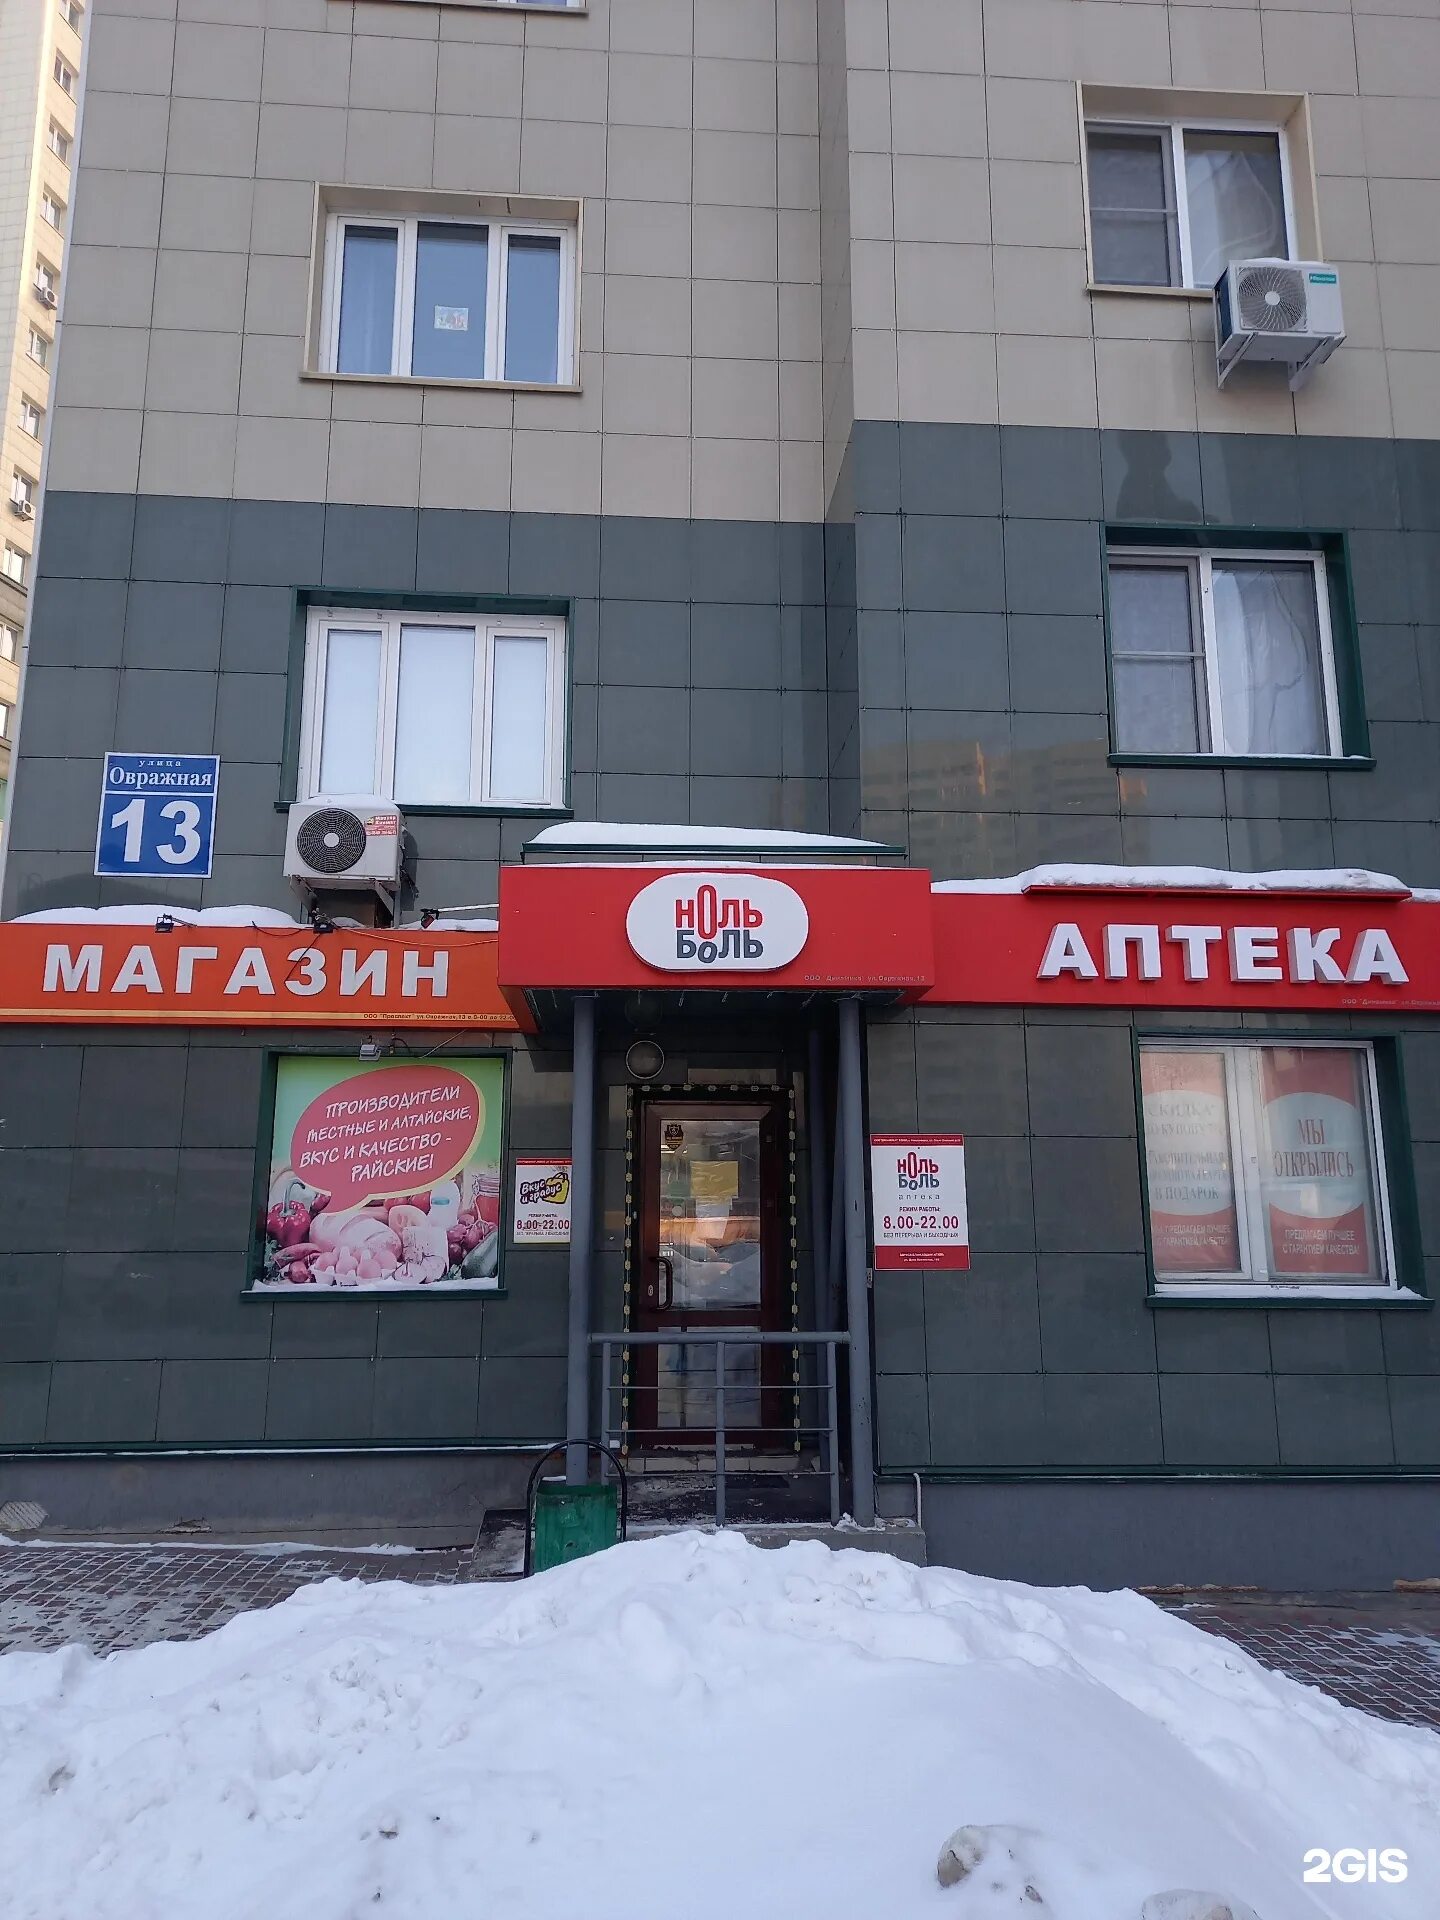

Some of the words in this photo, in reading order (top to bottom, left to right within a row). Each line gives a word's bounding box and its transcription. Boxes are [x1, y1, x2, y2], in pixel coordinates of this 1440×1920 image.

[109, 766, 213, 790] Овражная
[111, 798, 201, 865] 13
[1036, 923, 1410, 984] АПТЕКА
[42, 944, 449, 997] МАГАЗИН
[326, 1085, 460, 1119] ПРОИЗВОДИТЕЛИ
[306, 1119, 376, 1144] МЕСТНЫЕ
[379, 1118, 388, 1132] И
[391, 1106, 472, 1131] АЛТАЙСКИЕ,
[1298, 1119, 1326, 1145] МЫ
[299, 1149, 340, 1168] ВКУС
[344, 1145, 354, 1160] И
[358, 1132, 442, 1158] КАЧЕСТВО
[1274, 1151, 1354, 1177] ОТКРЫЛИСЬ
[351, 1153, 434, 1183] РАЙСКИЕ!
[1155, 1187, 1164, 1200] В
[1165, 1186, 1220, 1201] ПОДАРОК
[516, 1220, 570, 1230] 8.00-22.00
[883, 1215, 959, 1229] 8.00-22.00
